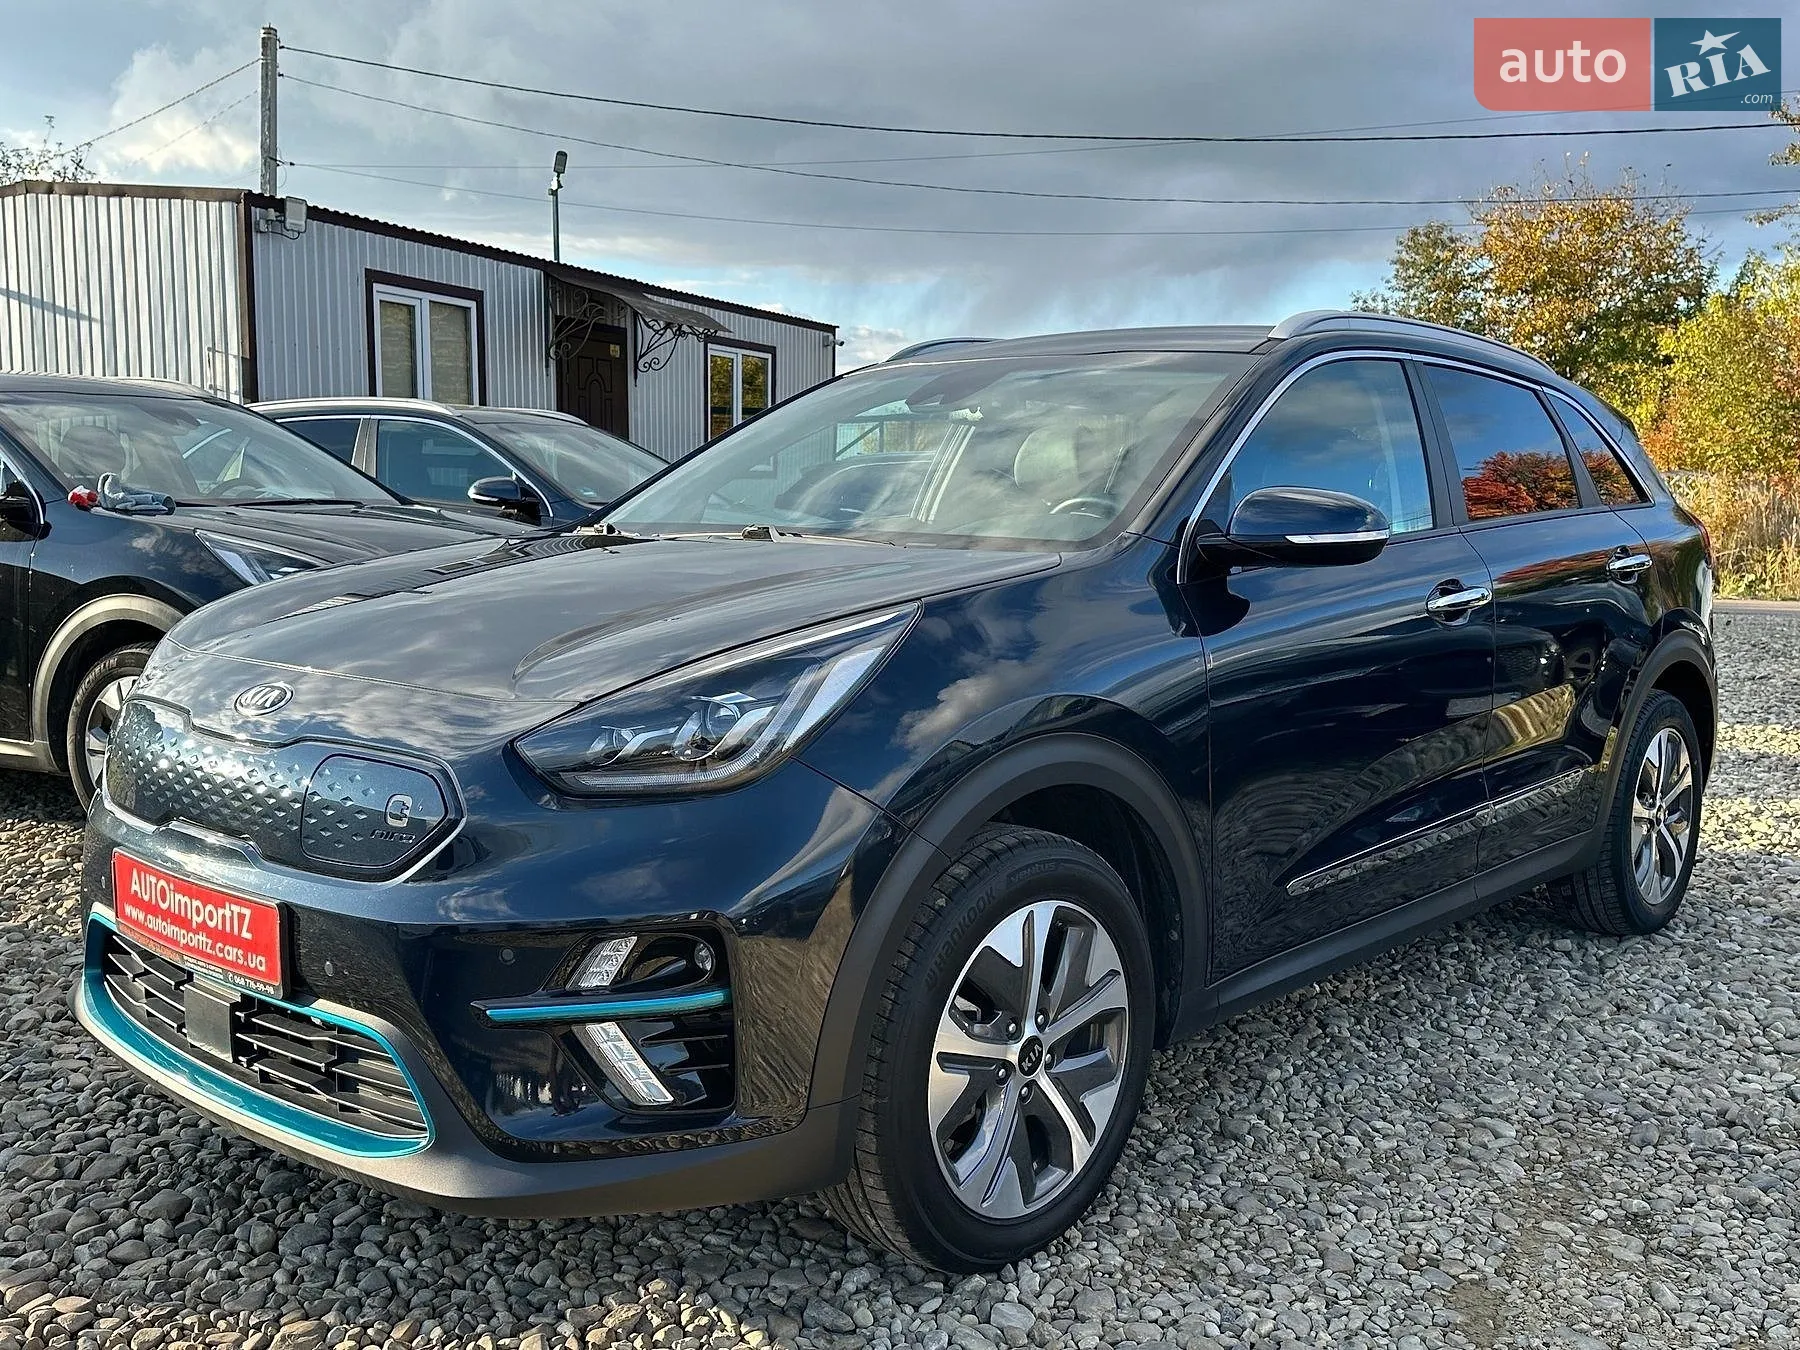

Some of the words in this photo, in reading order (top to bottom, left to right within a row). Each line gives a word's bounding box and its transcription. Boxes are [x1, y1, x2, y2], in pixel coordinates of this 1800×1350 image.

[76, 657, 118, 705] MICHELIN
[123, 901, 267, 972] www.autoimporttz.cars.ua
[1021, 1043, 1042, 1071] KIA
